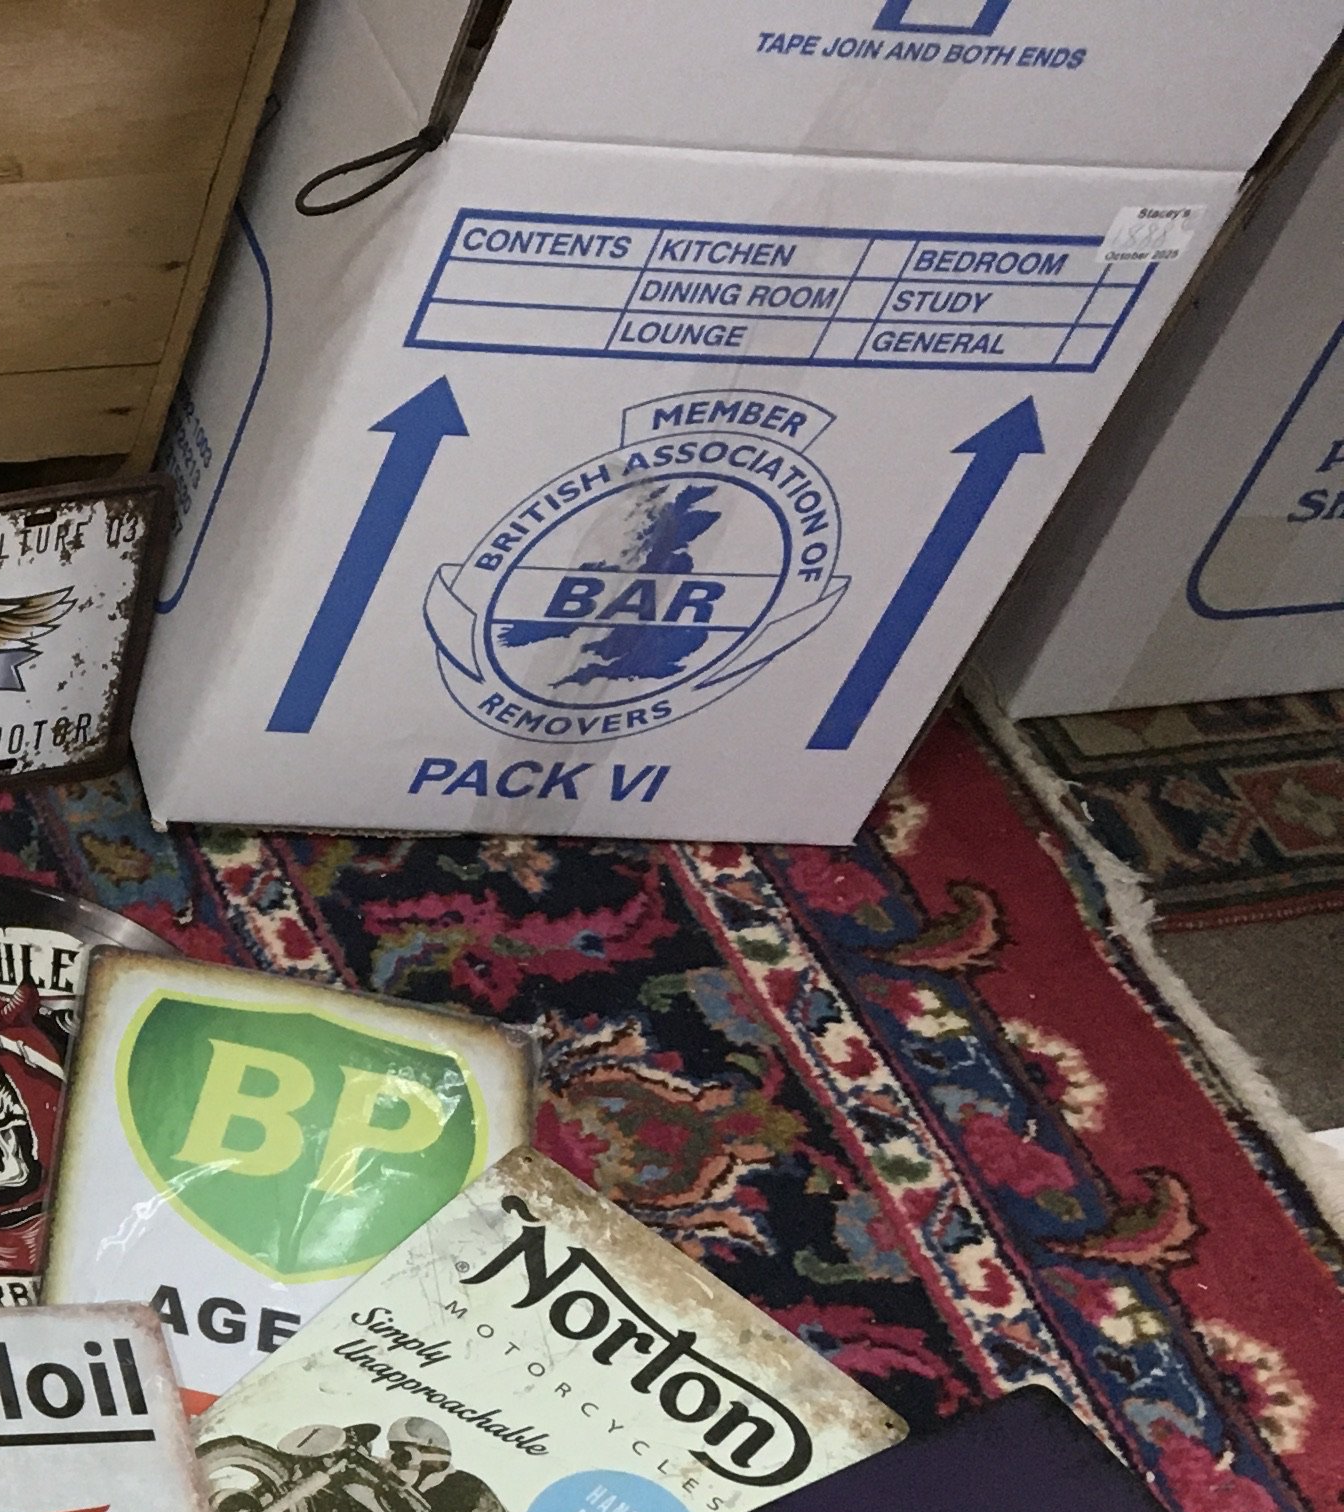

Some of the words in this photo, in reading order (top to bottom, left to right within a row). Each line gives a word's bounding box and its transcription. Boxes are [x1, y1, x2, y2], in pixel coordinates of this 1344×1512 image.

[756, 32, 821, 56] TAPE
[822, 36, 883, 60] JOIN
[884, 41, 941, 63] AND
[943, 44, 1012, 66] BOTH
[1015, 47, 1086, 70] ENDS
[1138, 208, 1191, 220] Stacey's
[462, 228, 632, 259] CONTENTS
[660, 239, 795, 268] KITCHEN
[914, 248, 1068, 276] BEDROOM
[1105, 251, 1149, 261] October
[638, 279, 742, 308] DINING
[748, 284, 840, 312] ROOM
[891, 290, 993, 315] STUDY
[618, 320, 745, 348] LOUNGE
[871, 330, 1005, 356] GENERAL
[652, 399, 808, 438] MEMBER
[474, 464, 611, 571] BRITISH
[622, 440, 828, 536] ASSOCIATION
[798, 547, 828, 583] OF
[544, 576, 727, 623] BAR
[478, 691, 673, 735] REMOVERS
[409, 756, 595, 801] PACK
[610, 763, 672, 803] VI
[179, 1037, 448, 1201] BP
[351, 1306, 453, 1368] Simply
[458, 1193, 814, 1488] Norton
[332, 1338, 551, 1459] Unapproachable
[443, 1300, 726, 1512] MOTORCYCLES
